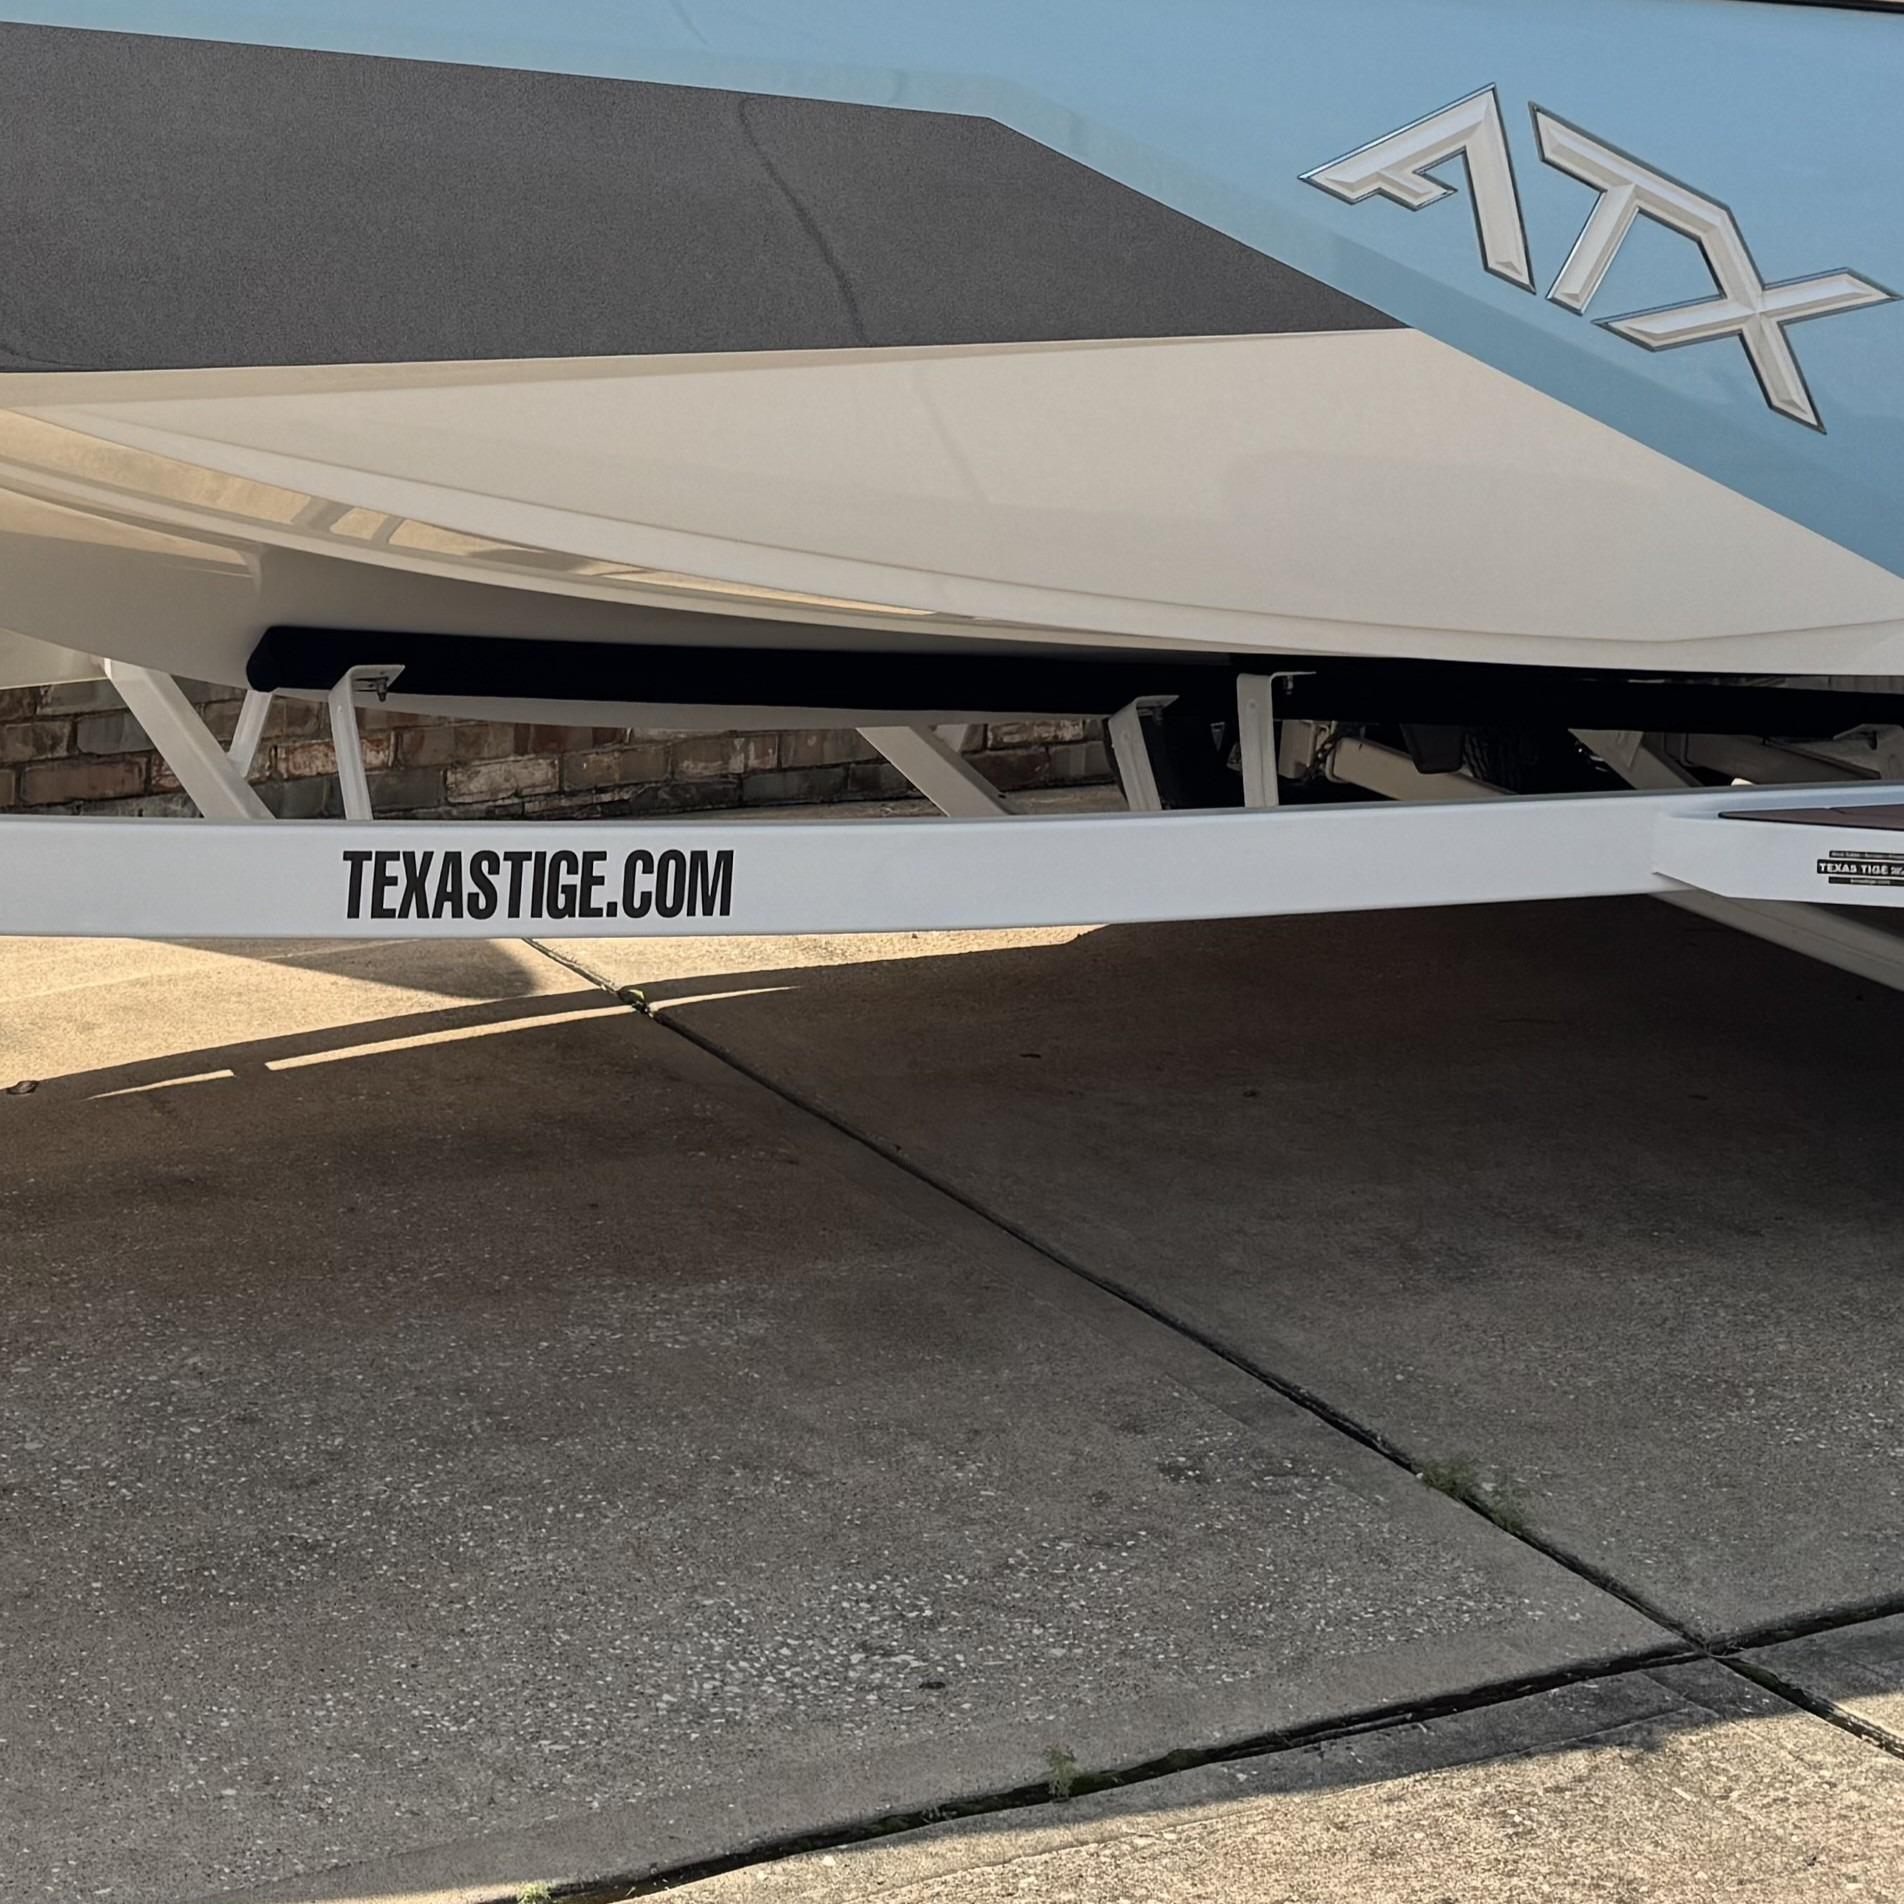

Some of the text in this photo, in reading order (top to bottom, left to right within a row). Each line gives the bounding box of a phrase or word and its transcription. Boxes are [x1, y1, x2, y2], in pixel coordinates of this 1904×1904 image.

[1296, 82, 1904, 434] ATX
[342, 848, 736, 920] TEXASTIGE.COM
[1819, 863, 1857, 873] TEXAS
